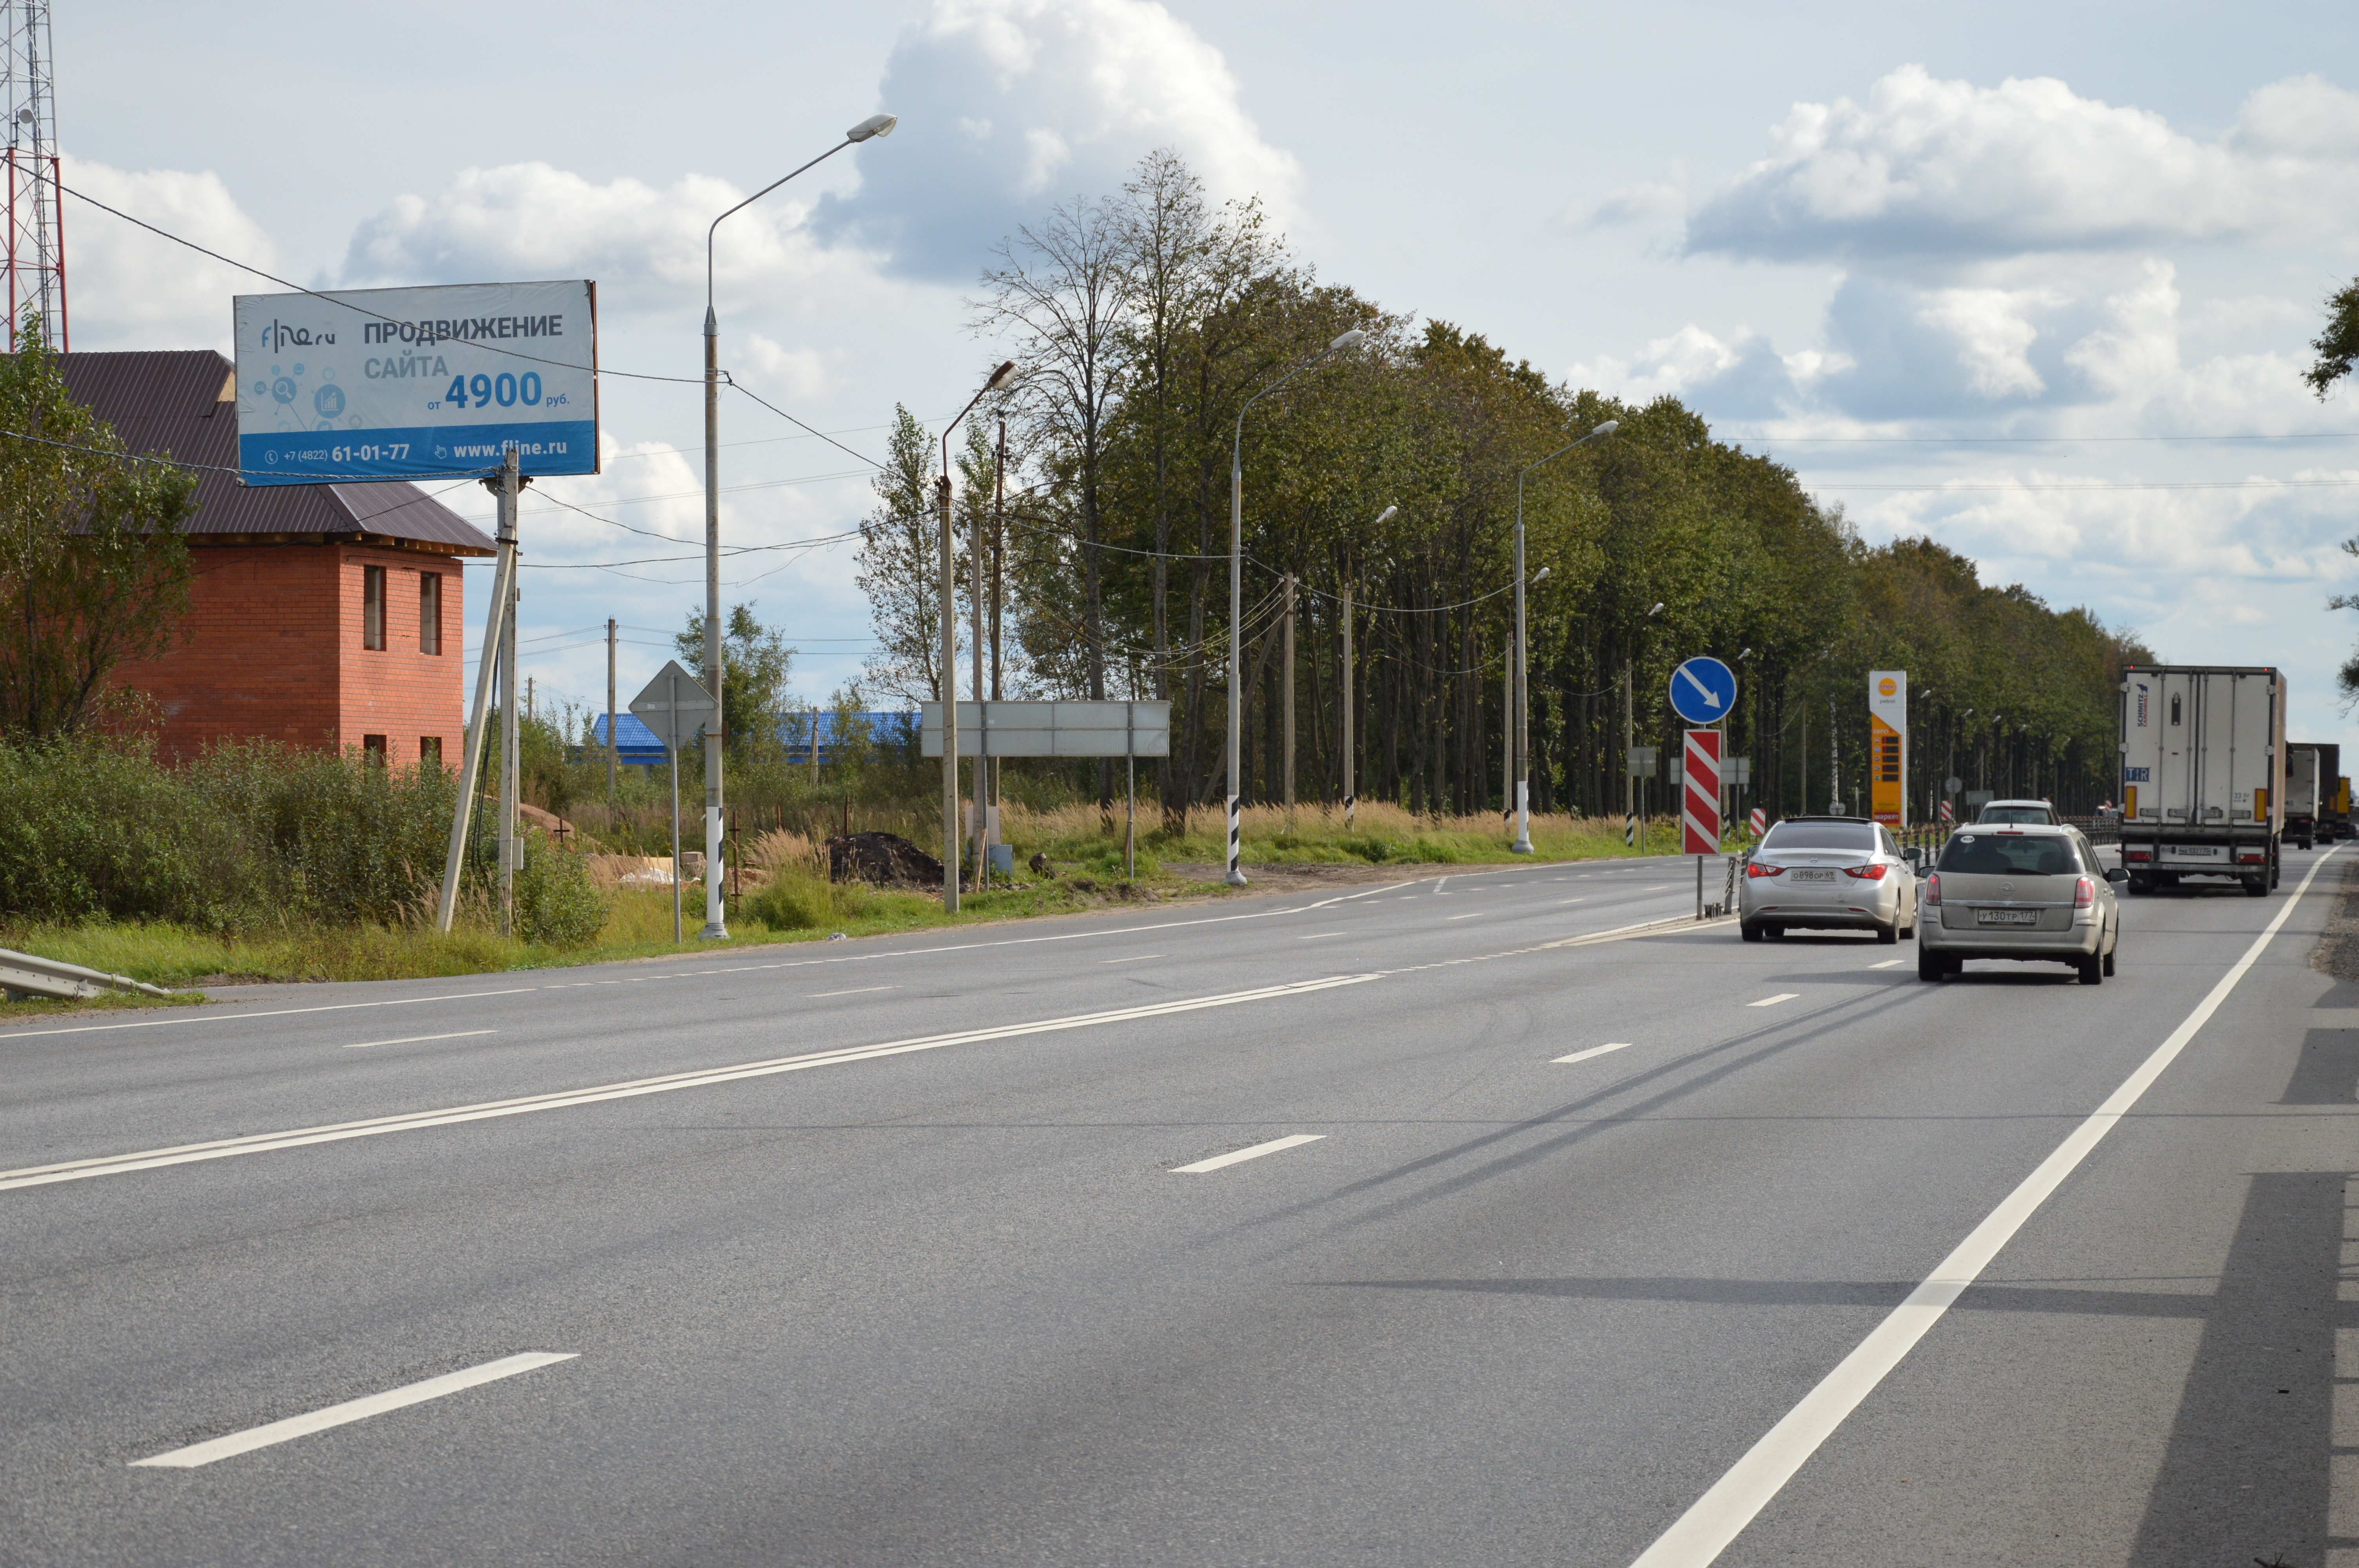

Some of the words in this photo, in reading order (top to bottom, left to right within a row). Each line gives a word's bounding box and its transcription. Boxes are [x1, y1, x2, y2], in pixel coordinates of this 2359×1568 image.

[364, 315, 563, 347] ПРОДВИЖЕНИЕ
[364, 350, 449, 379] САЙТА
[445, 372, 542, 408] 4900
[546, 394, 570, 407] руб.
[298, 450, 328, 463] (4822)
[332, 444, 409, 462] 61-01-77
[2128, 768, 2147, 781] TIR
